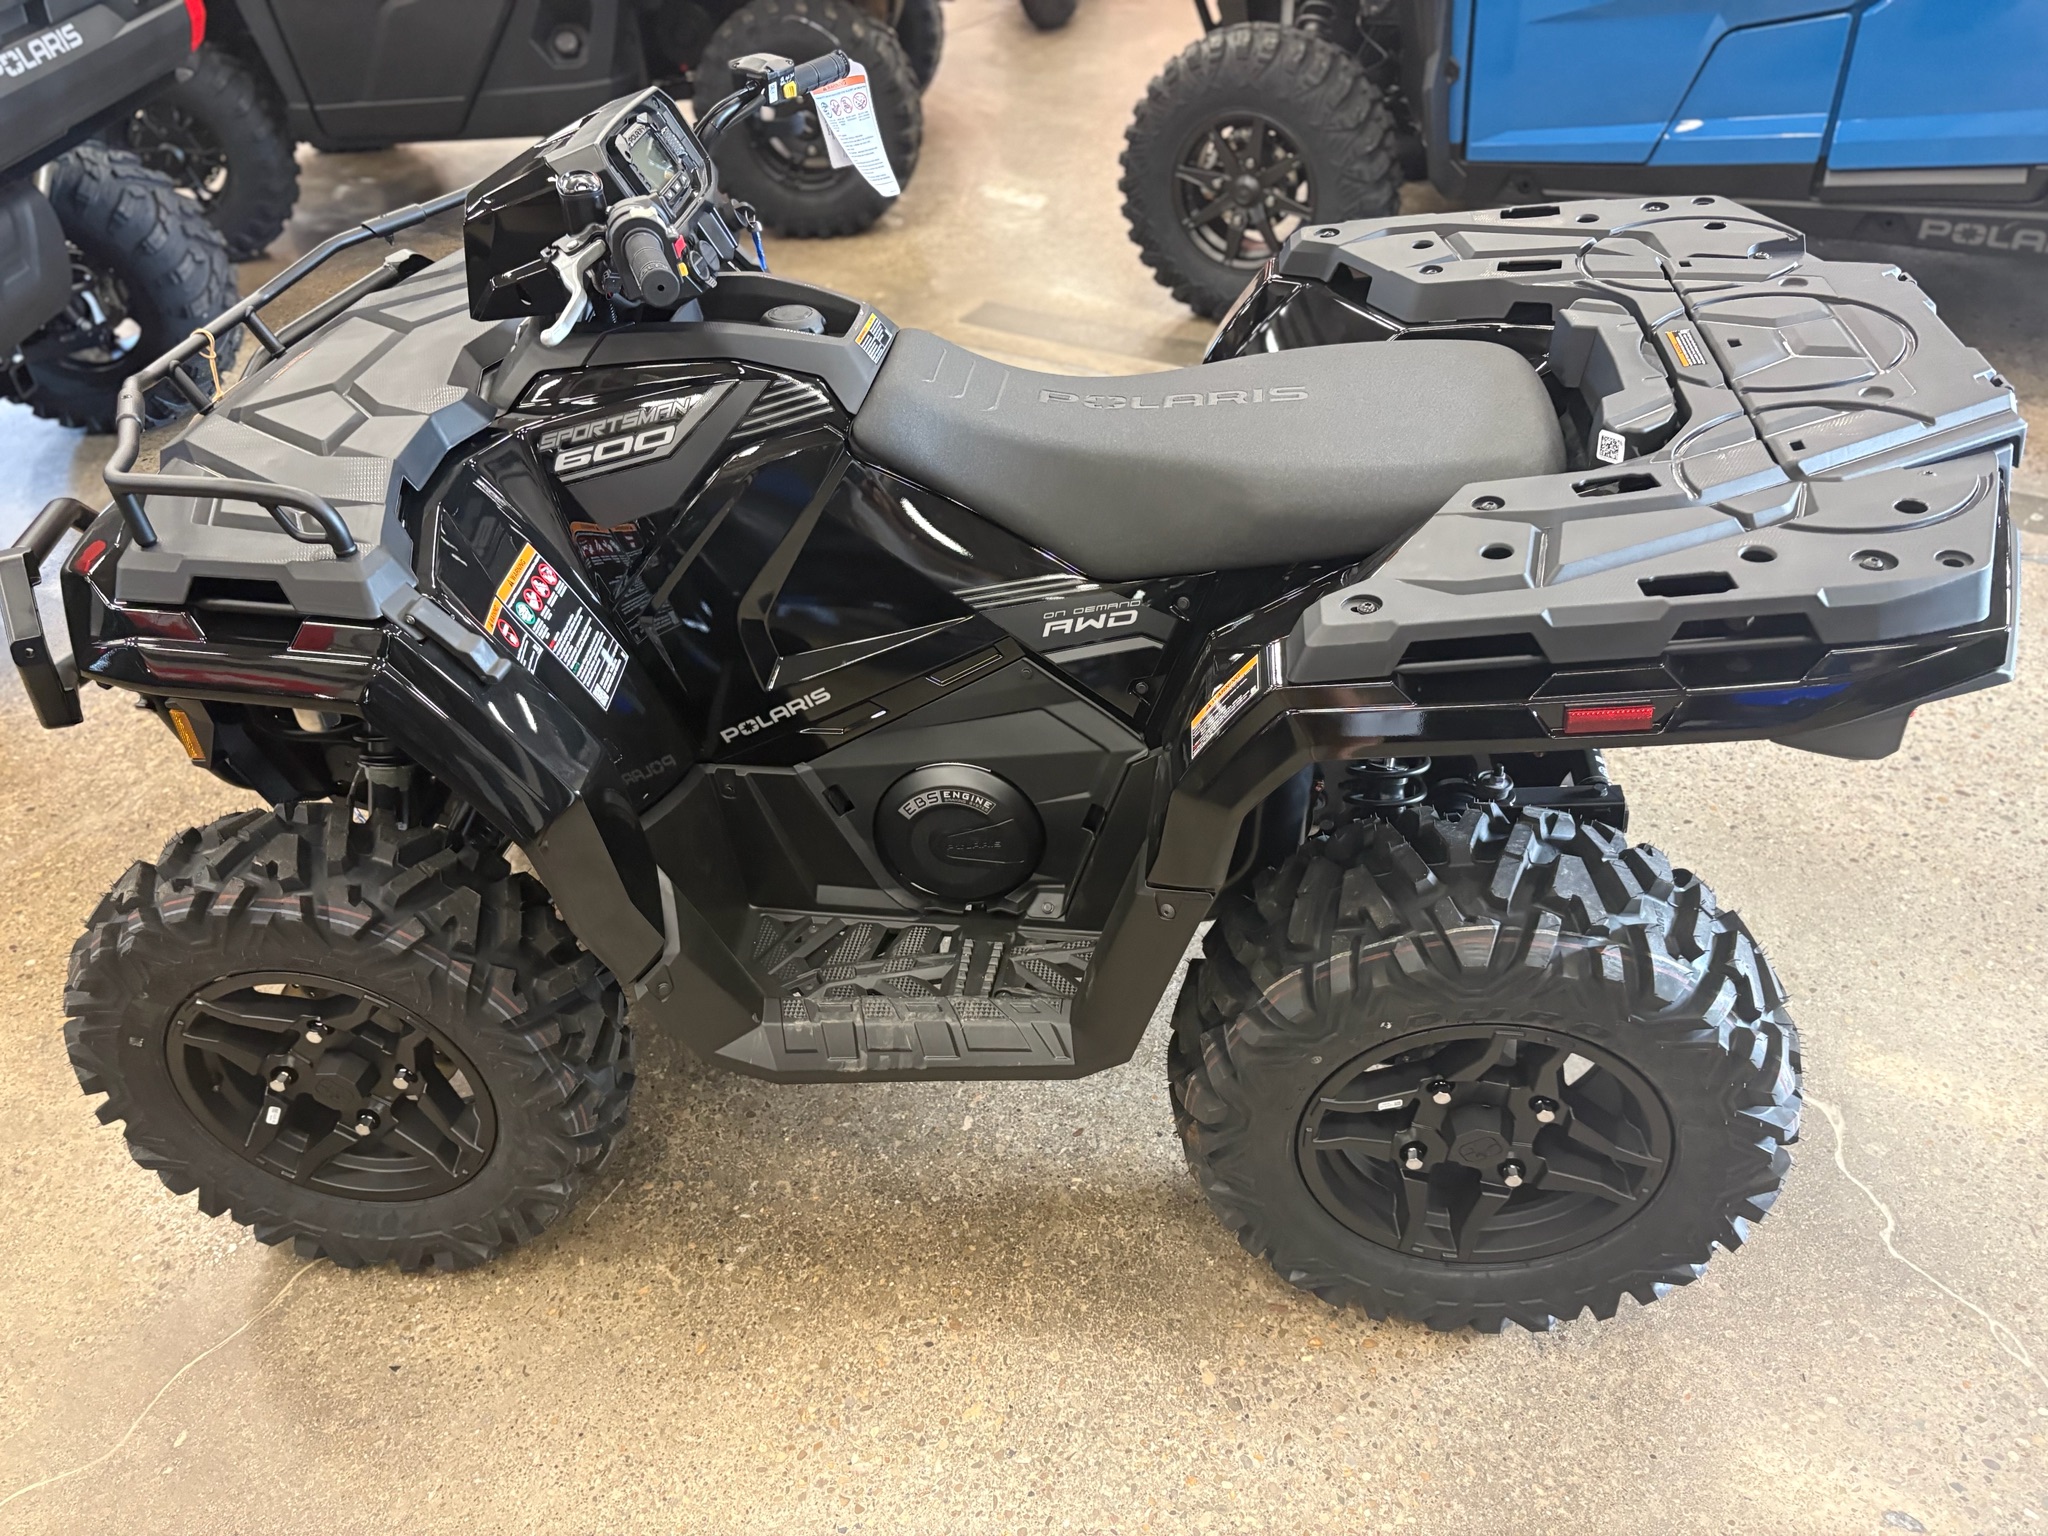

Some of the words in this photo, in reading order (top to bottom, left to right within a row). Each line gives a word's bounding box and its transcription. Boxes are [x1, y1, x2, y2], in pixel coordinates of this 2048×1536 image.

[1917, 218, 2048, 253] POLA
[1038, 386, 1309, 410] POLARIS
[539, 397, 693, 450] SPORTSMAN
[554, 424, 676, 472] 600
[1042, 609, 1139, 638] AWD
[1043, 610, 1067, 620] ON
[1073, 600, 1141, 615] DEMAND
[720, 687, 832, 744] POLARIS
[903, 792, 939, 816] EBS
[943, 791, 993, 809] ENGINE
